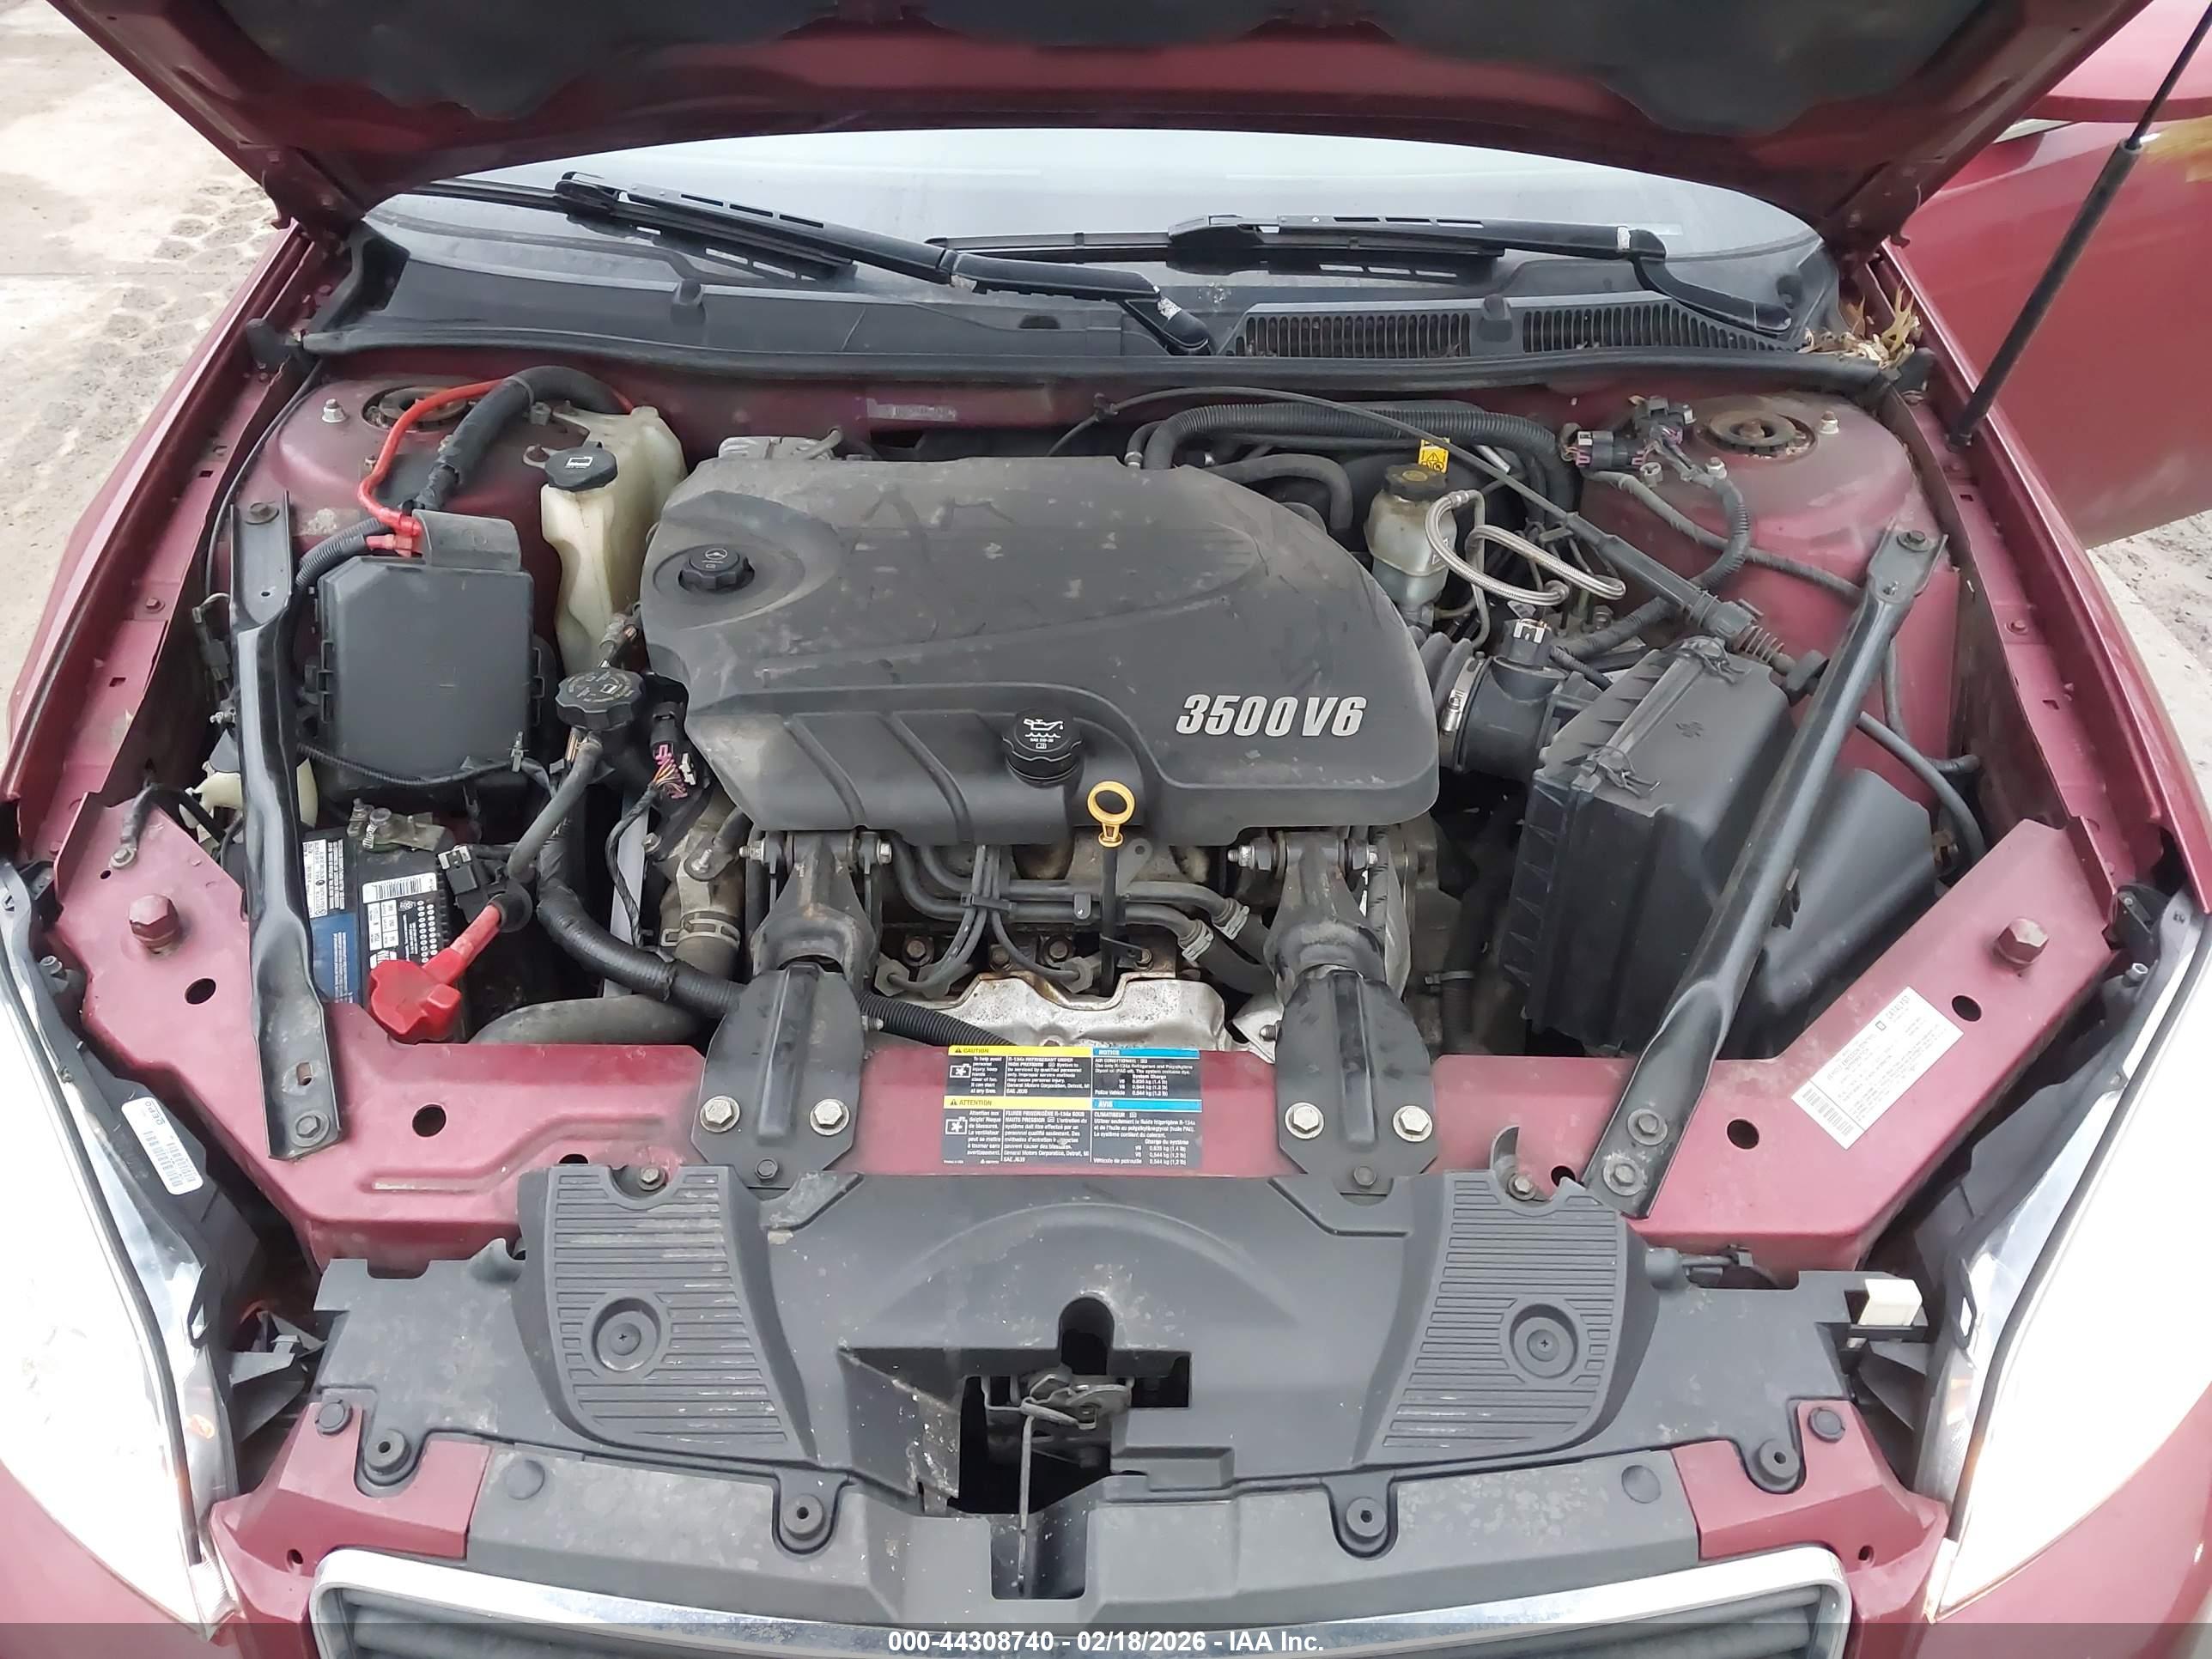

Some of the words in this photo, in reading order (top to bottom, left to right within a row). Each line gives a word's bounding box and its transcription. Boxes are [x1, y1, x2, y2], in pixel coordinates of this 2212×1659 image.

[1176, 694, 1298, 737] 3500
[1302, 696, 1367, 737] V6
[145, 1101, 163, 1125] DEPO
